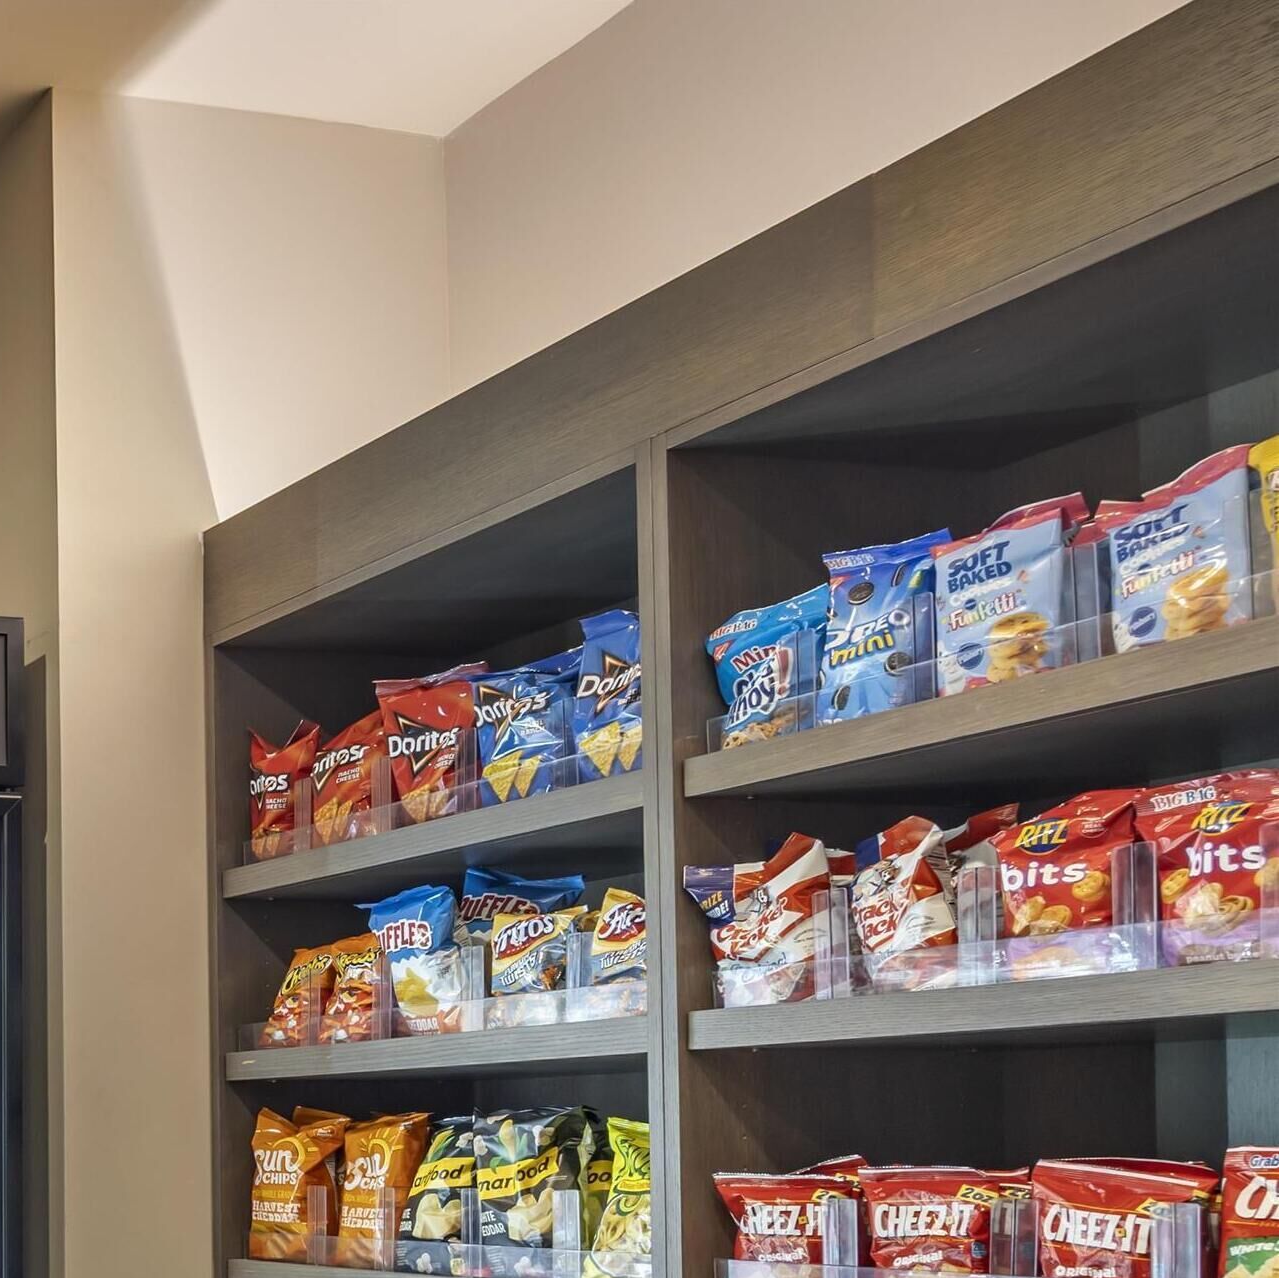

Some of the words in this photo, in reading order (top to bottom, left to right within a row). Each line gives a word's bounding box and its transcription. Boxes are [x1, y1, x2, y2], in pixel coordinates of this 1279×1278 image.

[1113, 503, 1188, 547] SOFT
[946, 540, 1011, 578] SOFT
[1116, 523, 1191, 563] BAKED
[946, 560, 1013, 594] BAKED
[830, 630, 895, 667] mini
[387, 727, 460, 758] Doritos
[1152, 794, 1184, 812] BIG
[1190, 801, 1254, 831] RITZ
[1013, 818, 1070, 849] RITZ
[1000, 860, 1088, 893] bits
[1186, 842, 1267, 878] bits
[261, 1171, 299, 1185] CHIPS
